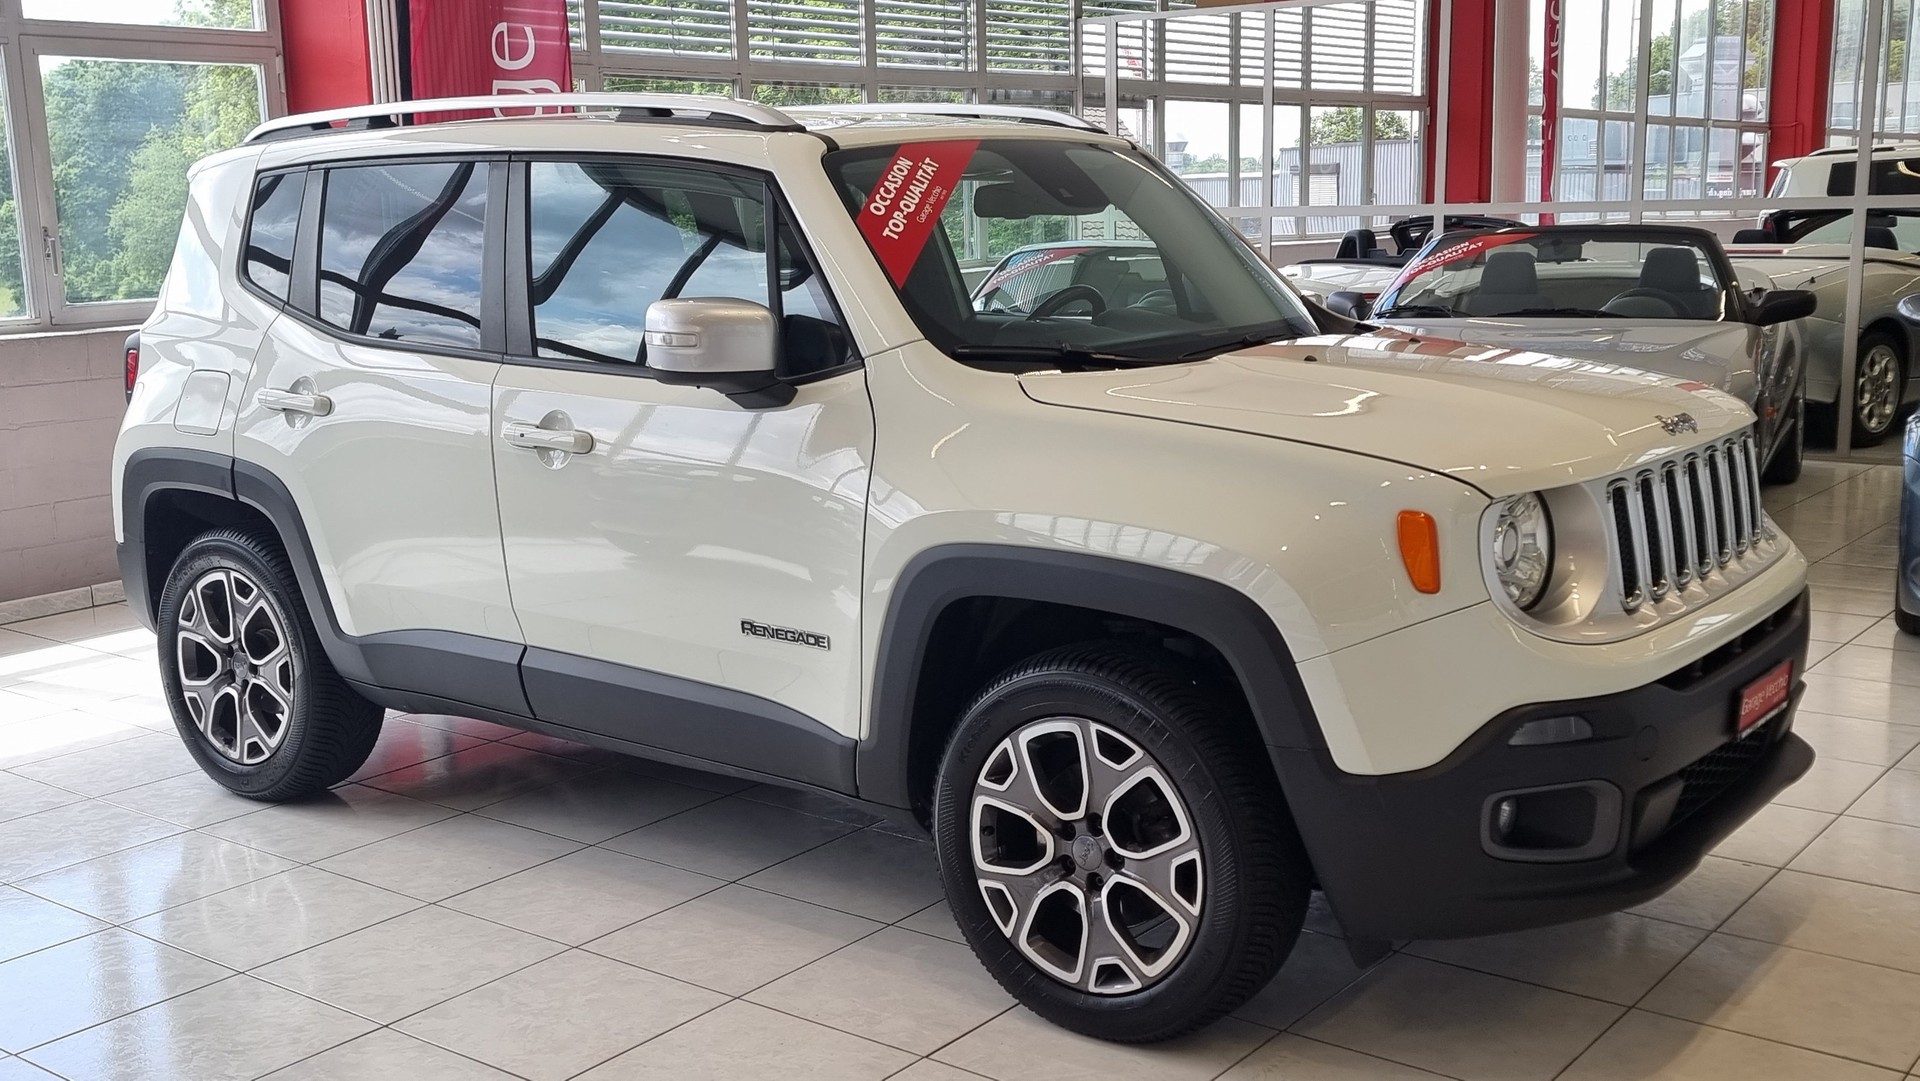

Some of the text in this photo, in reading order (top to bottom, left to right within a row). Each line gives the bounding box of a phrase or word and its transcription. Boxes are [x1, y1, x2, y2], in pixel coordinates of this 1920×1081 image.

[868, 156, 914, 216] OCCASION
[882, 156, 940, 240] TOP-QUALITÄT
[916, 185, 943, 224] Garage Vecchio
[740, 619, 830, 650] RENEGADE
